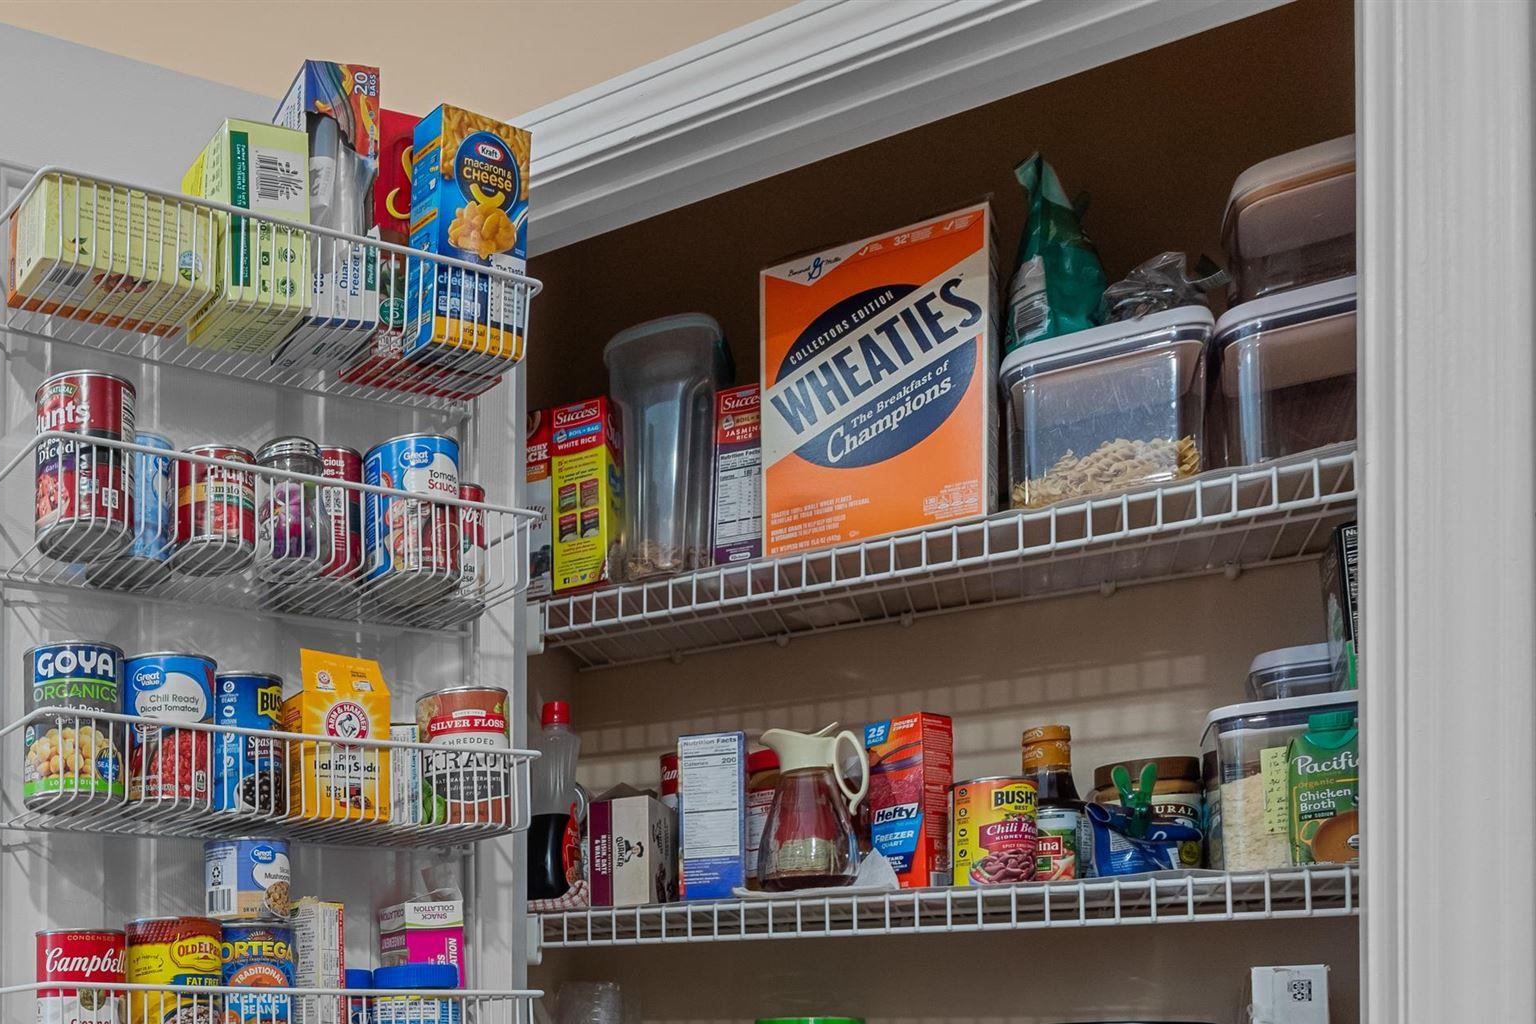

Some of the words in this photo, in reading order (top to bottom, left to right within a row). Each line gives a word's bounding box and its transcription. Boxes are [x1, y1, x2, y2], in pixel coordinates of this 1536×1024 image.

[354, 72, 369, 96] 20
[369, 74, 377, 97] BAGS
[480, 145, 499, 159] Kraft
[464, 157, 505, 177] macaroni
[506, 171, 512, 180] &
[350, 256, 360, 298] Freezer
[789, 319, 850, 365] COLLECTORS
[853, 290, 894, 324] EDITION
[770, 278, 983, 435] WHEATIES
[851, 410, 873, 428] The
[876, 374, 933, 412] Breakfast
[935, 360, 949, 378] of
[556, 406, 598, 425] Success
[827, 377, 952, 464] Champions
[726, 424, 760, 437] JASMIN
[736, 433, 753, 441] RICE
[558, 438, 579, 450] WHITE
[580, 436, 597, 446] RICE
[403, 450, 428, 461] Great
[428, 478, 457, 494] Sauce
[37, 650, 114, 678] GOYA
[136, 672, 160, 682] Great
[141, 678, 161, 686] Value
[34, 682, 118, 703] ORGANICS
[149, 694, 169, 703] Chili
[172, 694, 200, 706] Ready
[140, 704, 163, 713] Diced
[164, 704, 199, 713] Tomatoes
[328, 711, 339, 730] ARM
[343, 704, 367, 731] HAMMER
[893, 718, 918, 727] DOUBLE
[430, 719, 470, 732] SILVER
[474, 718, 504, 728] FLOSS
[892, 723, 915, 731] ZIPPER
[868, 726, 885, 739] 25
[683, 738, 715, 747] Nutrition
[1300, 788, 1351, 802] Chicken
[1300, 799, 1335, 812] Broth
[876, 805, 916, 823] Hefty
[987, 823, 1017, 835] Chili
[875, 830, 914, 843] FREEZER
[615, 836, 624, 868] QUAKER
[881, 841, 903, 849] QUART
[253, 849, 272, 858] Great
[414, 904, 454, 912] COLLATION
[221, 941, 293, 963] ORTEGA
[186, 977, 202, 986] FAT
[204, 978, 220, 986] FREE
[235, 966, 284, 985] TRADITIONAL
[242, 1004, 279, 1015] BEANS
